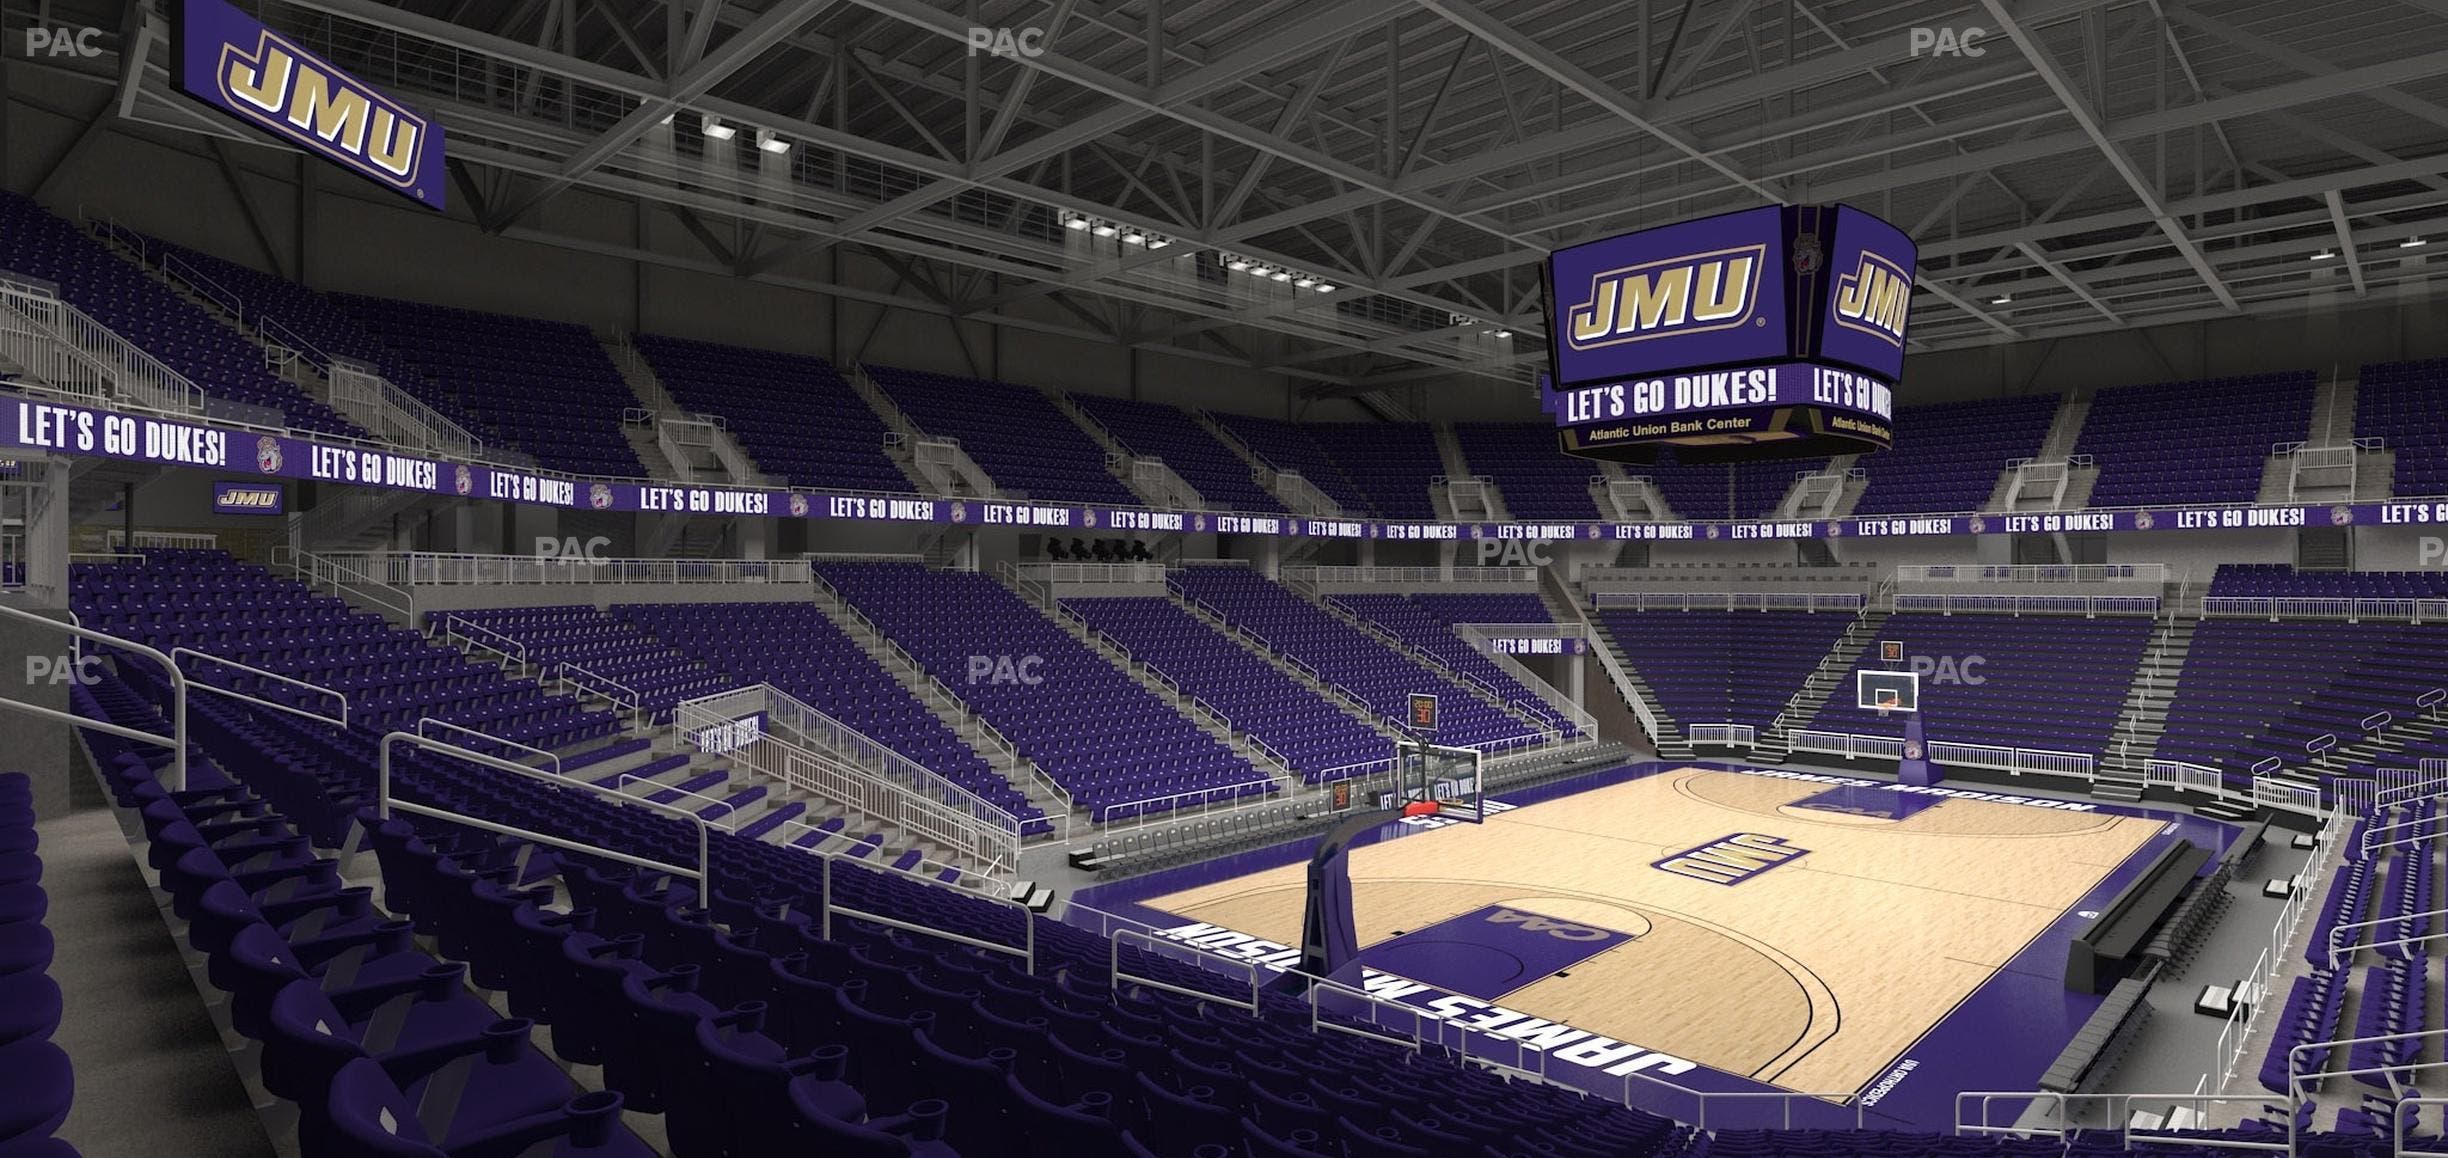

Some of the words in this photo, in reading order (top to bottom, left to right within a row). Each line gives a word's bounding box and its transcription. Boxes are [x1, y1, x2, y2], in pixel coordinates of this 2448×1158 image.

[228, 47, 418, 177] JMU
[1574, 256, 1753, 342] JMU
[1567, 383, 1626, 422] LET'S
[1633, 379, 1665, 414] GO
[1675, 368, 1777, 412] DUKES!
[1814, 367, 1853, 407] LET'S
[1856, 376, 1870, 411] GO
[20, 403, 94, 451] LET'S
[105, 416, 137, 456] GO
[146, 421, 226, 466] DUKES!
[1589, 426, 1630, 441] Atlantic
[1632, 423, 1667, 437] Union
[1670, 420, 1703, 433] Bank
[1706, 417, 1752, 430] Center
[312, 446, 357, 481] LET'S
[362, 453, 382, 484] GO
[387, 456, 437, 490] DUKES!
[220, 491, 276, 506] JMU
[491, 472, 520, 499] LET'S
[524, 476, 537, 502] GO
[540, 479, 574, 506] DUKES!
[641, 488, 685, 511] LET'S
[690, 490, 710, 512] GO
[715, 492, 768, 514] DUKES!
[831, 497, 866, 518] LET'S
[870, 499, 886, 519] GO
[890, 500, 934, 521] DUKES!
[984, 505, 1013, 524] LET'S
[1016, 506, 1030, 525] GO
[1033, 507, 1070, 526] DUKES!
[1111, 511, 1136, 529] LET'S
[1138, 512, 1150, 529] GO
[1152, 513, 1183, 531] DUKES!
[2006, 516, 2040, 533] LET'S
[2044, 516, 2061, 532] GO
[2065, 514, 2114, 531] DUKES!
[2178, 511, 2218, 529] LET'S
[2223, 510, 2243, 527] GO
[2248, 508, 2305, 527] DUKES!
[2382, 504, 2430, 523] LET'S
[2436, 503, 2448, 522] G
[1218, 517, 1239, 533] LET'S
[1241, 518, 1251, 533] GO
[1253, 518, 1279, 534] DUKES!
[1309, 521, 1327, 536] LET'S
[1328, 522, 1338, 537] GO
[1339, 523, 1362, 538] DUKES!
[1387, 525, 1406, 539] LET'S
[1408, 525, 1421, 539] GO
[1423, 525, 1457, 539] DUKES!
[1498, 525, 1524, 539] LET'S
[1526, 525, 1539, 539] GO
[1541, 525, 1575, 539] DUKES!
[1616, 525, 1642, 539] LET'S
[1644, 525, 1657, 539] GO
[1659, 525, 1693, 539] DUKES!
[1732, 525, 1758, 539] LET'S
[1761, 524, 1774, 538] GO
[1776, 523, 1813, 538] DUKES!
[1859, 521, 1888, 536] LET'S
[1892, 520, 1906, 535] GO
[1910, 518, 1952, 535] DUKES!
[1493, 638, 1516, 654] LET'S
[1518, 638, 1530, 654] GO
[1531, 638, 1562, 654] DUKES!
[1417, 708, 1431, 723] 30
[1740, 769, 1880, 787] JAMES
[1879, 784, 2098, 812] MADISON
[1659, 833, 1802, 885] JMU
[1484, 909, 1611, 941] CAA
[1405, 994, 1698, 1078] JAMES
